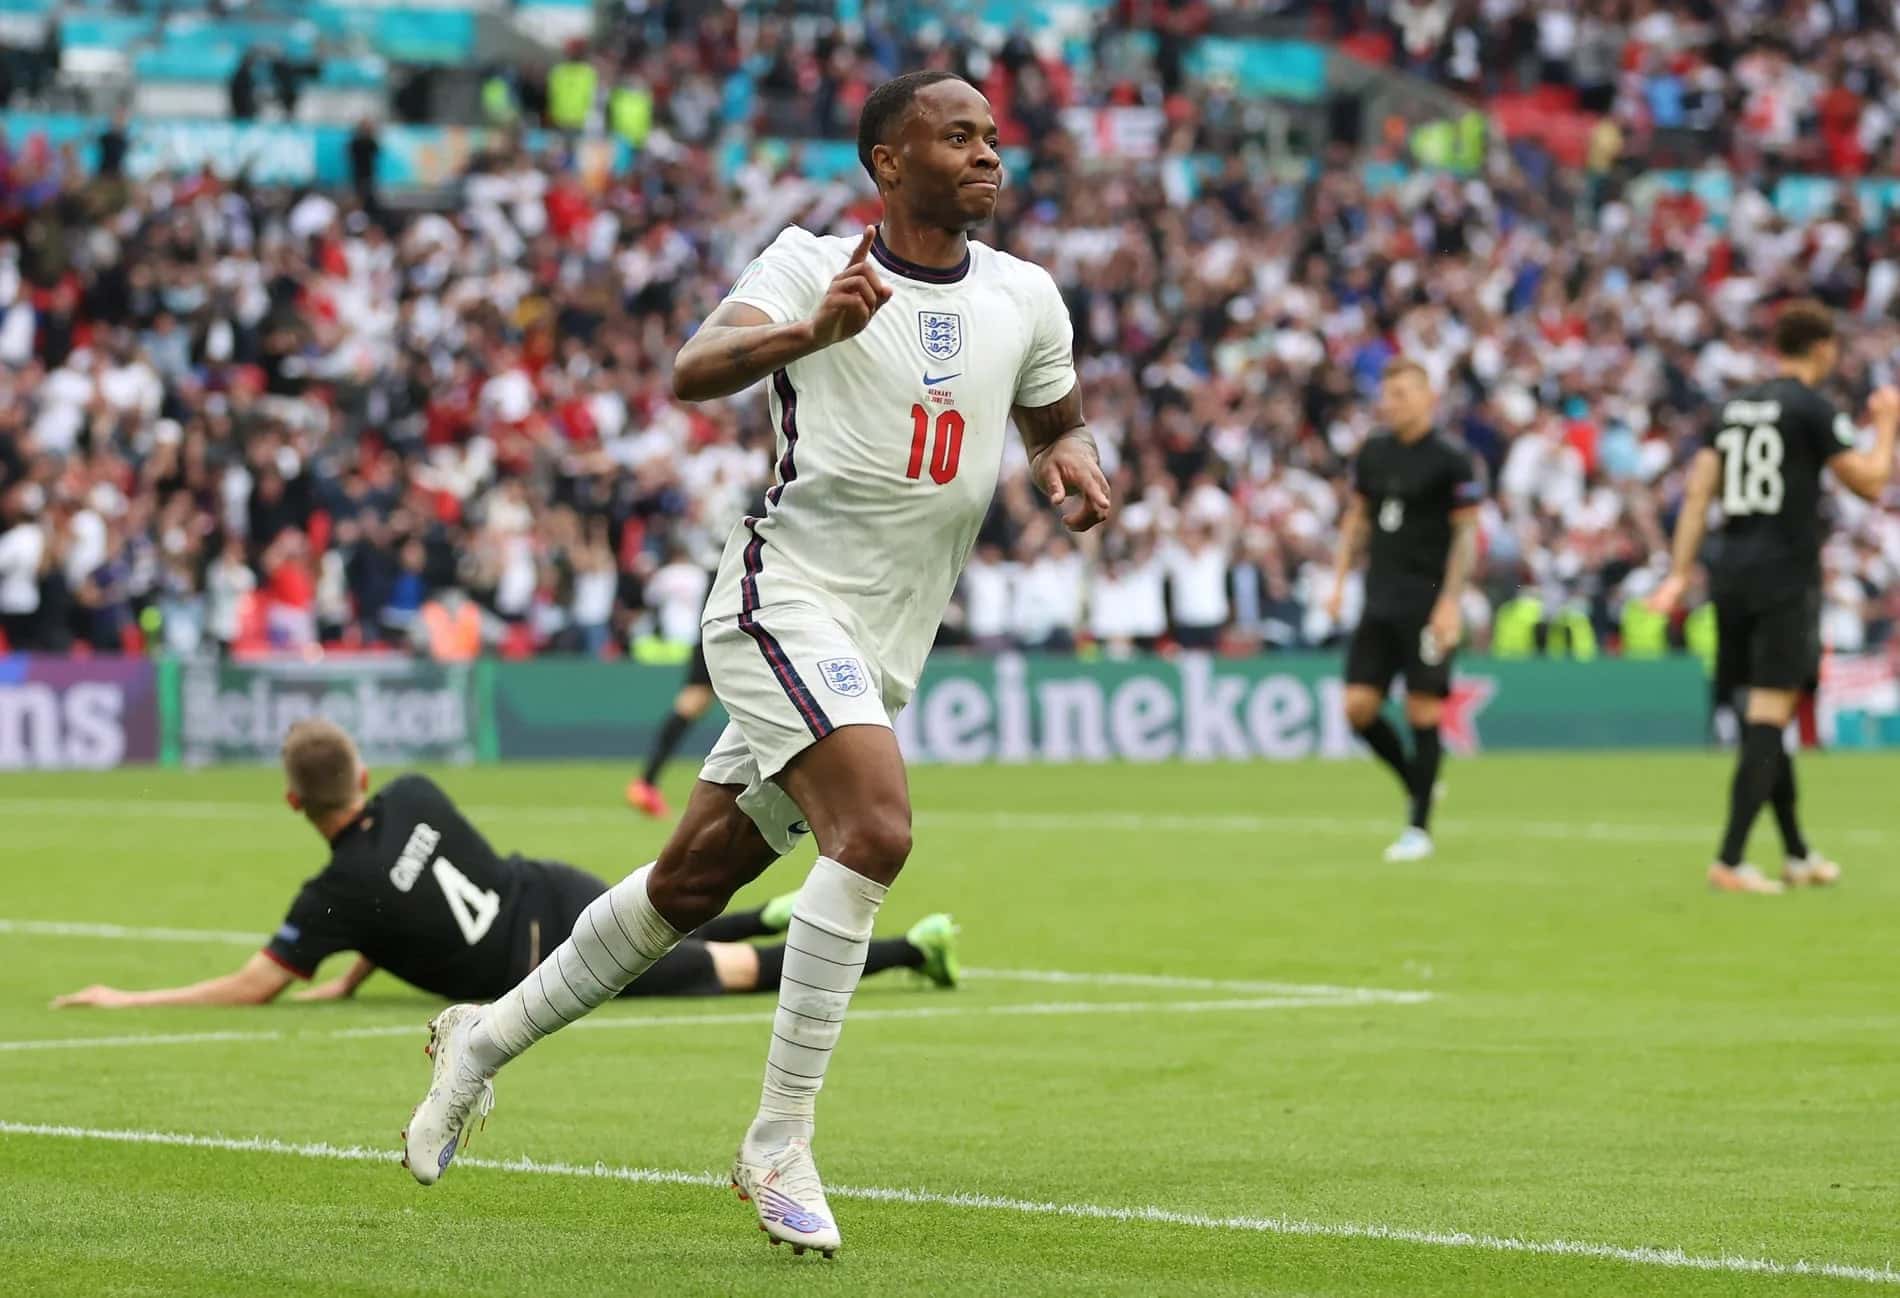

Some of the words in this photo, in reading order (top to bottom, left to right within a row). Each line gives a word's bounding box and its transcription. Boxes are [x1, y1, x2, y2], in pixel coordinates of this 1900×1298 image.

[906, 403, 966, 486] 10
[1715, 424, 1785, 516] 18
[432, 856, 500, 946] 4
